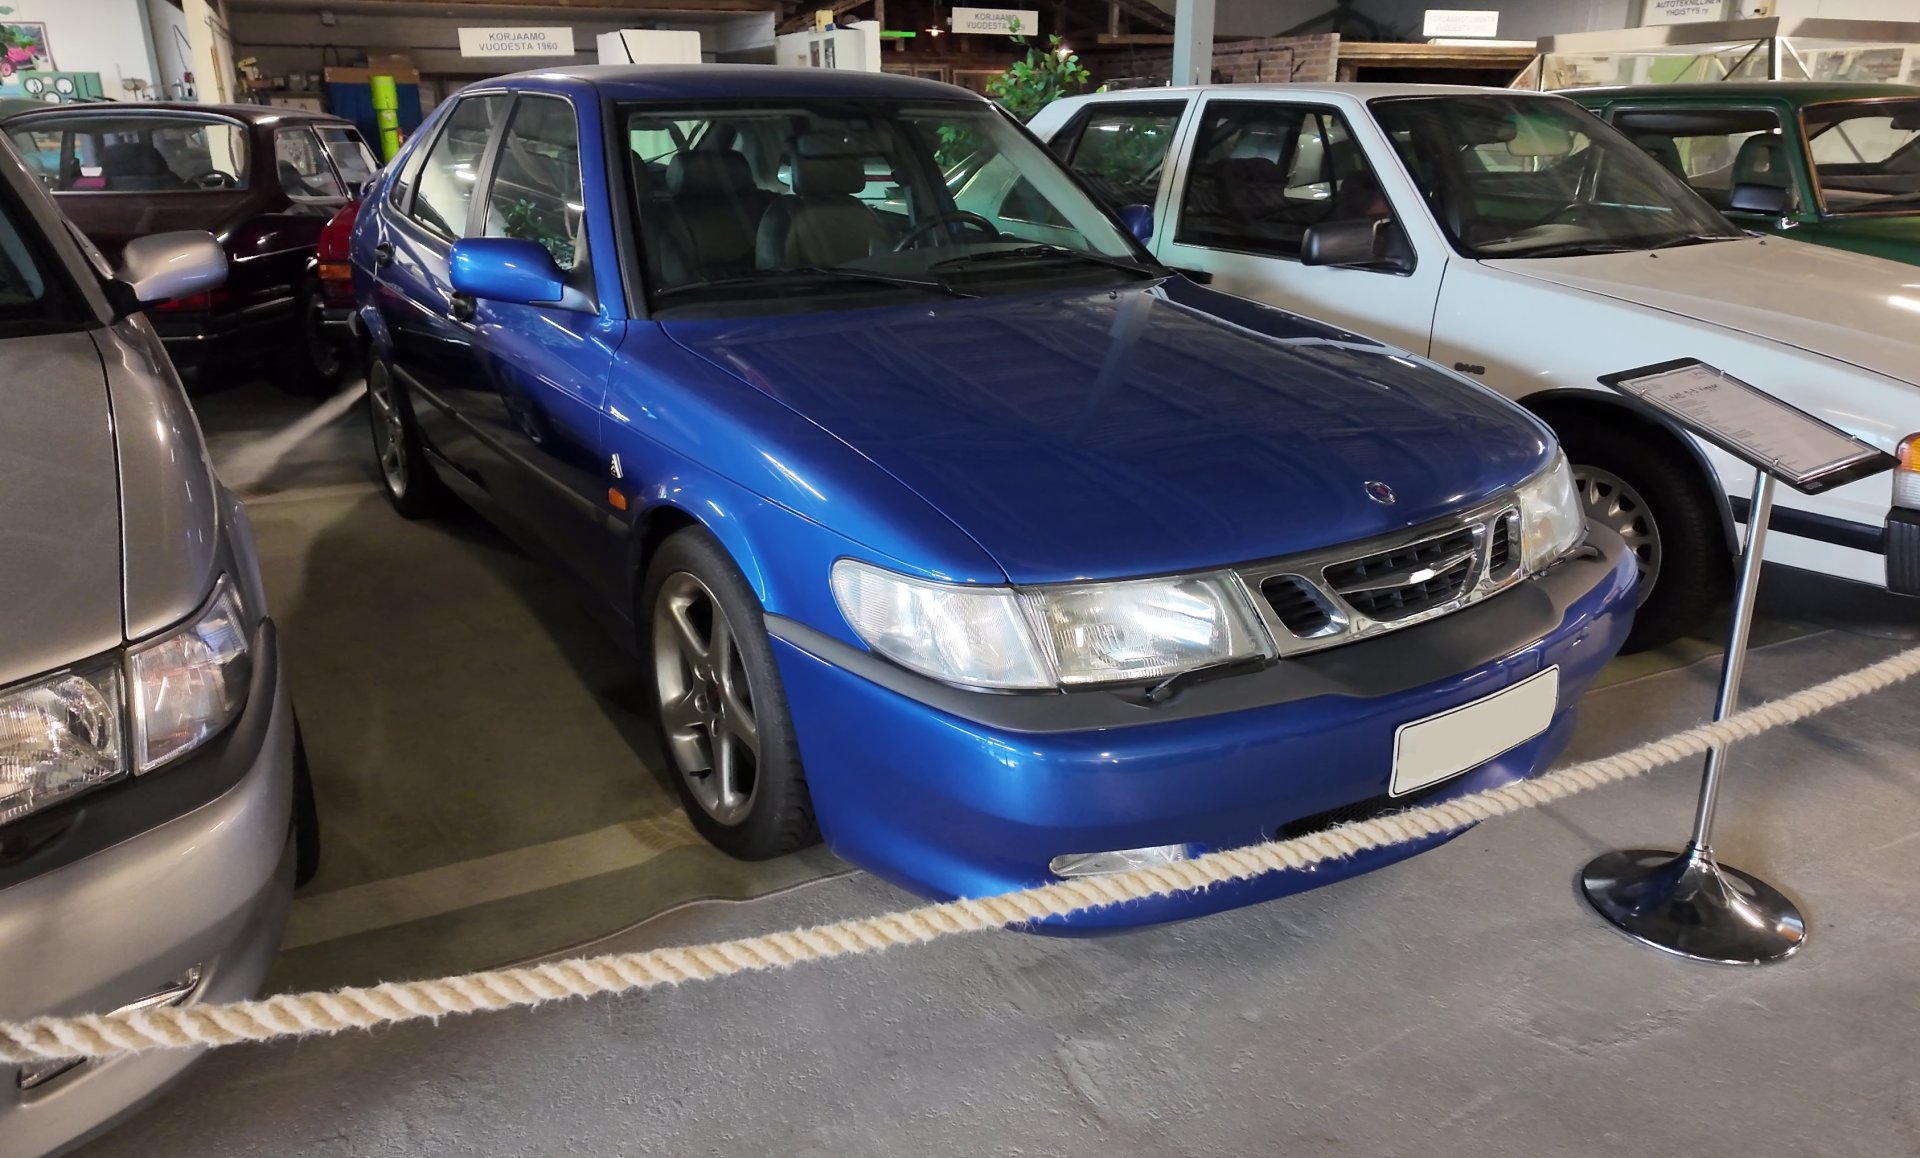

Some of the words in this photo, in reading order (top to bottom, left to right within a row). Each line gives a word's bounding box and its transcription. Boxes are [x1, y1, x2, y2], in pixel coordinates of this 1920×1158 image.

[1666, 7, 1700, 16] YHDISTYS
[966, 21, 1007, 30] VUODESTA
[488, 32, 546, 41] KORJAAMO
[479, 42, 534, 51] VUODESTA
[537, 42, 558, 51] 1960
